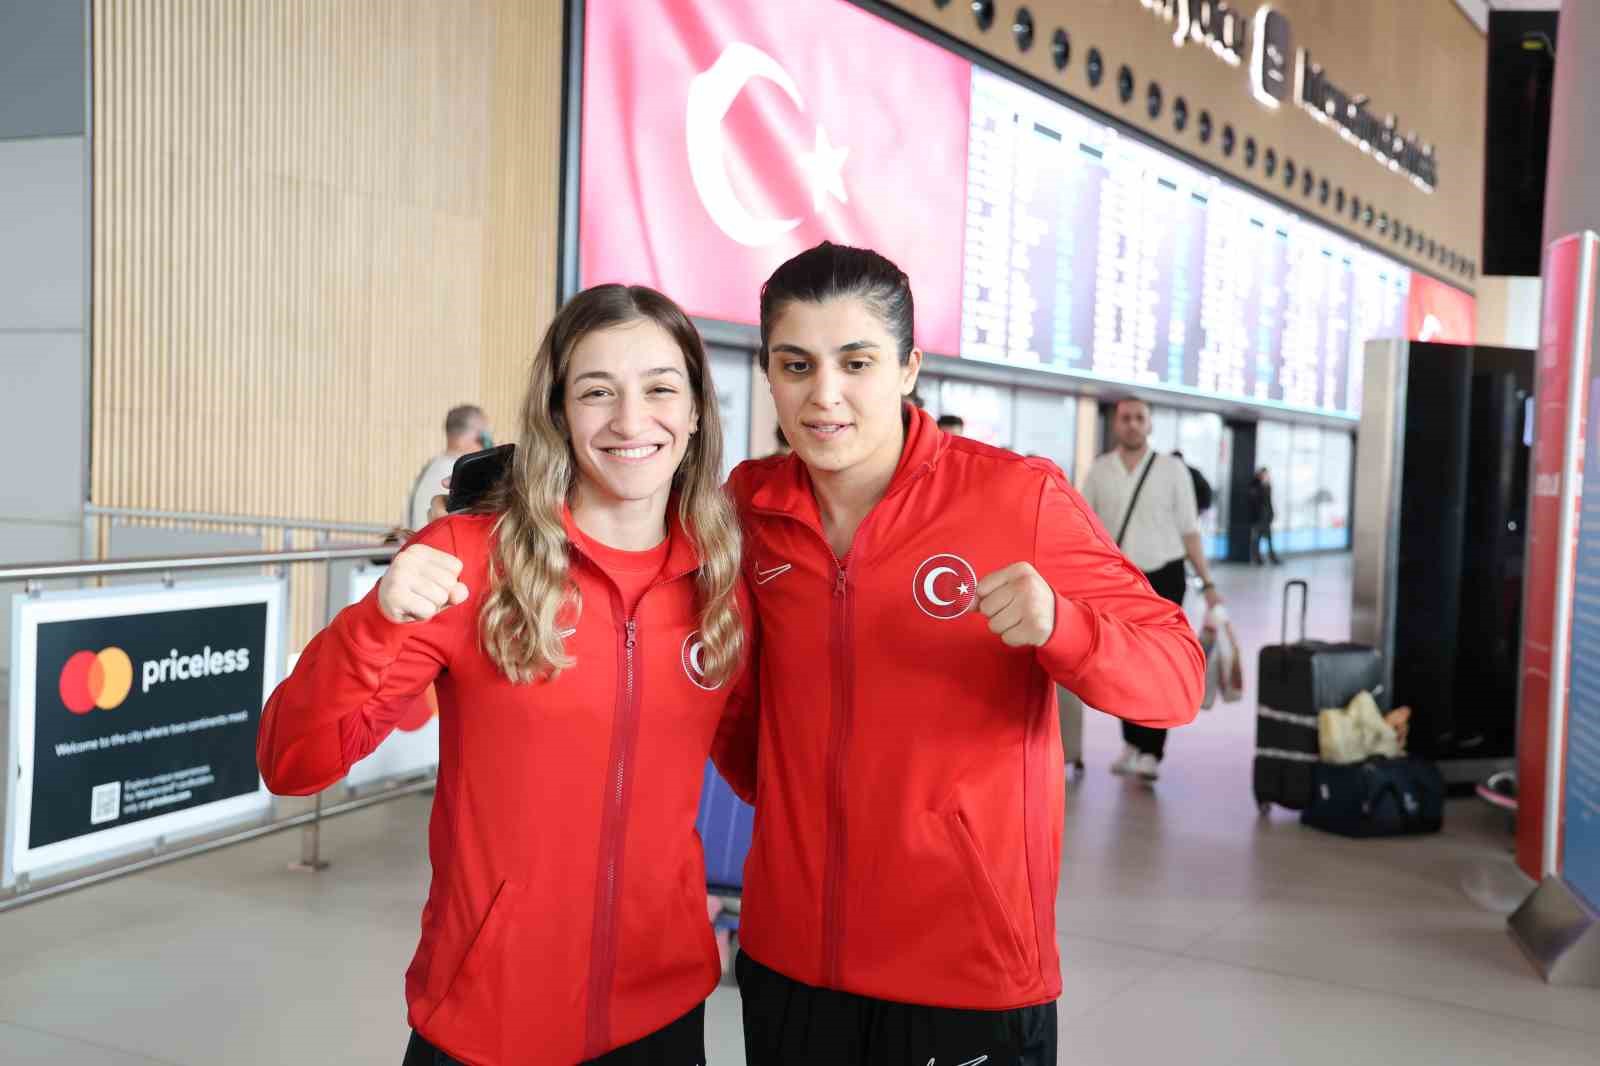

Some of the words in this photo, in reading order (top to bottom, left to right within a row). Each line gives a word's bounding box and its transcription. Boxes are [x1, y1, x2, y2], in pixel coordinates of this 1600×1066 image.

[142, 645, 250, 693] priceless
[55, 739, 98, 757] Welcome
[99, 737, 110, 749] to
[111, 733, 126, 746] the
[126, 730, 143, 744] city
[143, 726, 169, 740] where
